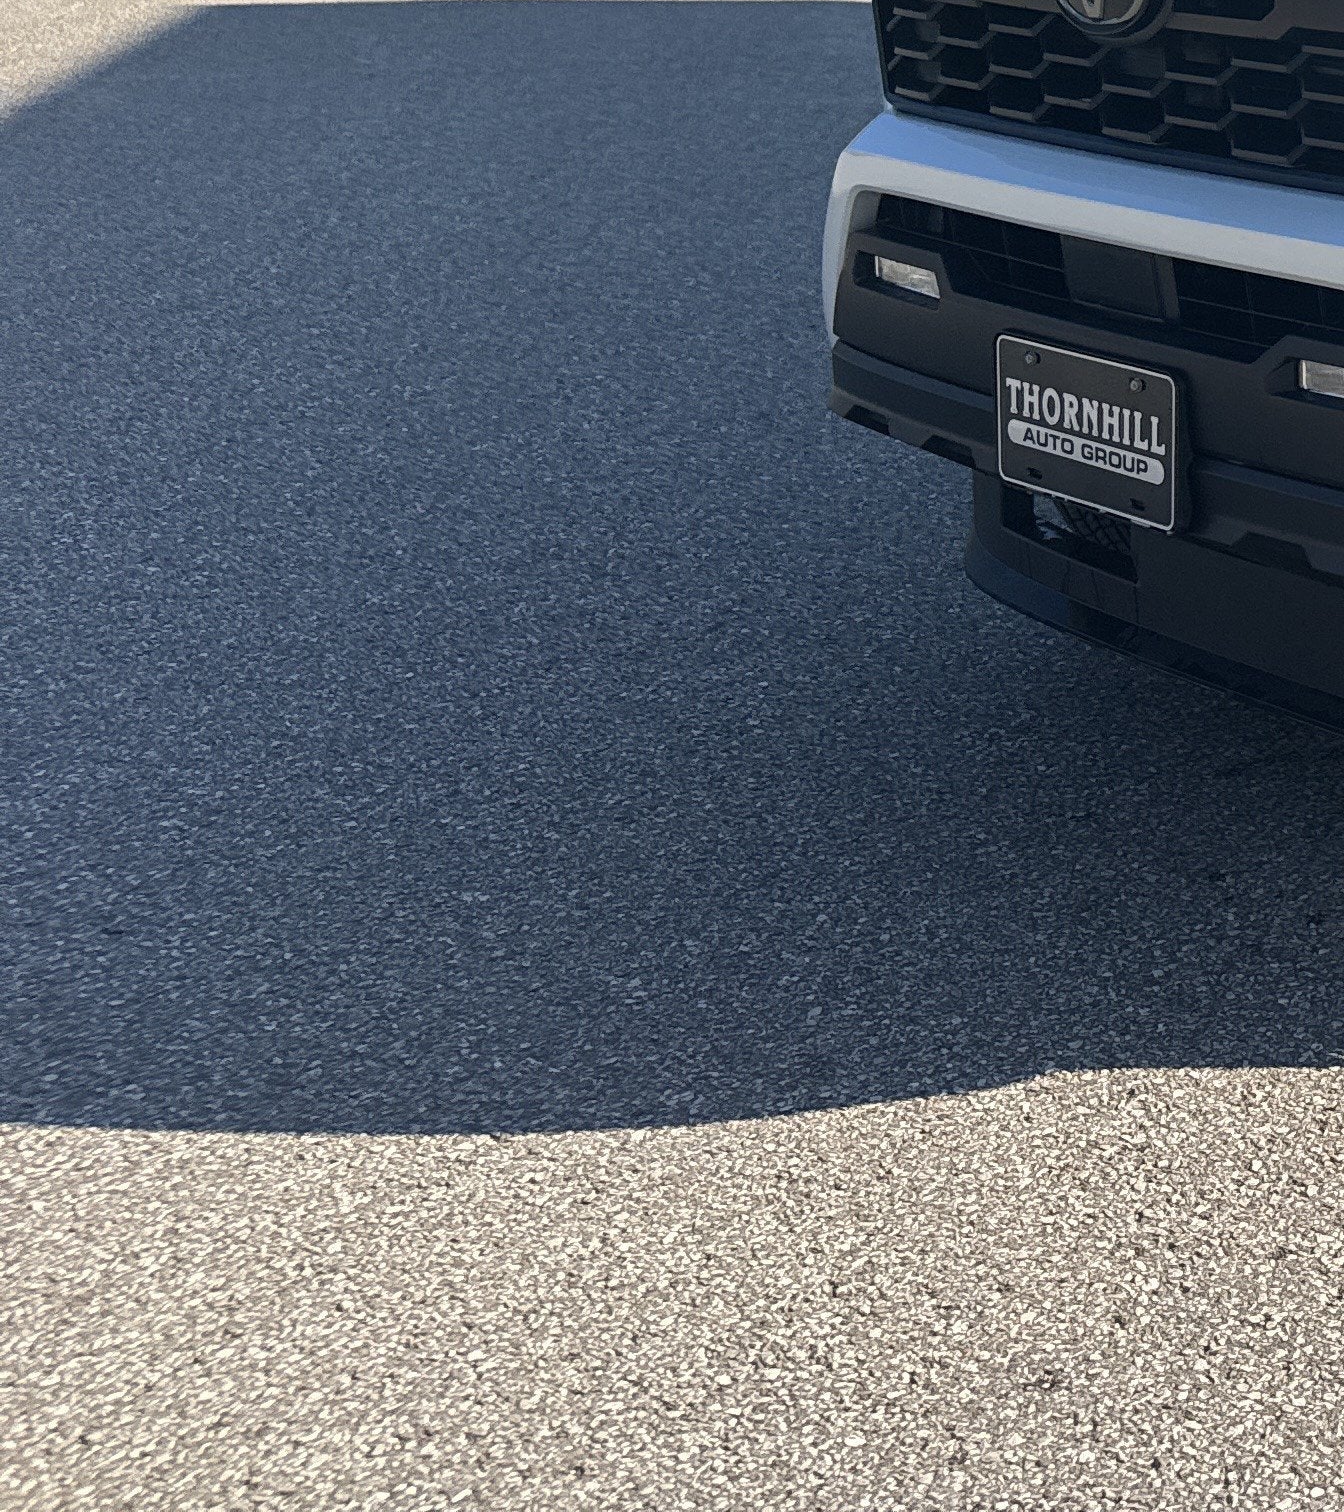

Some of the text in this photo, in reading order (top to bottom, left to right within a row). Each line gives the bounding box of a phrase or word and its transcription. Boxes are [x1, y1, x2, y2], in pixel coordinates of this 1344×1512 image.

[1006, 377, 1166, 456] THORNHILL
[1023, 427, 1148, 475] AUTO GROUP
